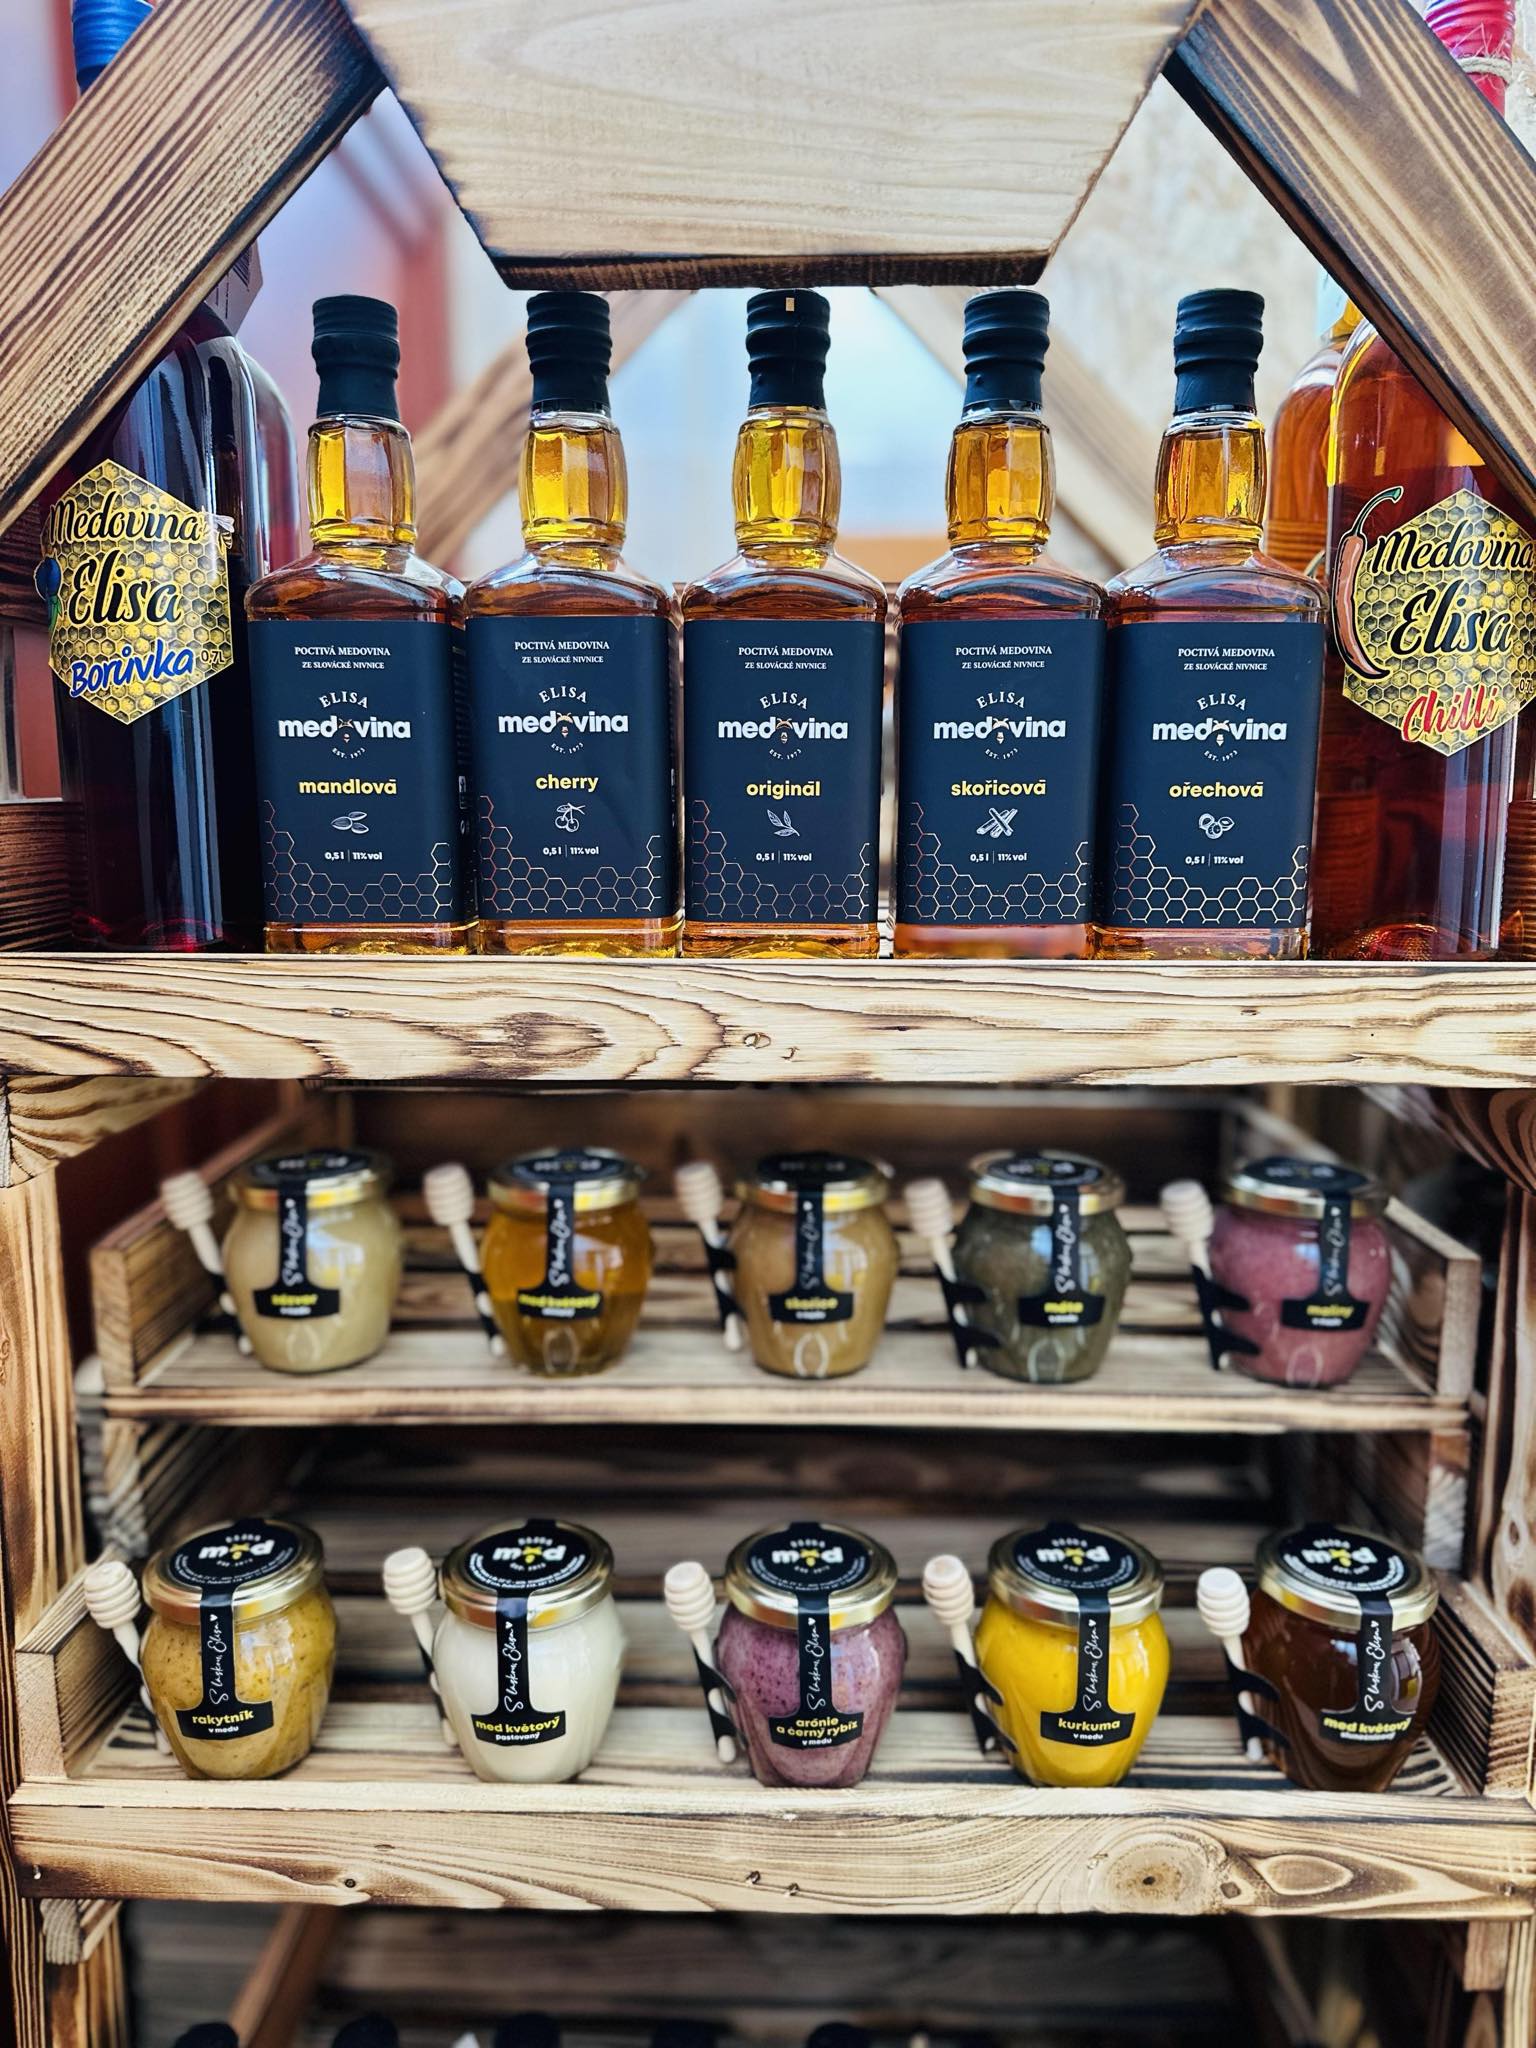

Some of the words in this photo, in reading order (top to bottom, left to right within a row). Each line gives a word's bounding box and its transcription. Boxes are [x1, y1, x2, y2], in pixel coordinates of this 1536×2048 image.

[49, 490, 201, 544] Medovina
[1370, 519, 1535, 575] Medovina
[68, 549, 182, 624] Elisa
[1390, 578, 1514, 655] Elisa
[295, 645, 336, 656] POCTIVÁ
[339, 646, 390, 656] MEDOVINA
[514, 639, 556, 650] POCTIVÁ
[558, 640, 610, 650] MEDOVINA
[738, 645, 780, 656] POCTIVÁ
[782, 646, 833, 656] MEDOVINA
[956, 645, 997, 656] POCTIVÁ
[1000, 646, 1052, 655] MEDOVINA
[1178, 646, 1220, 657] POCTIVÁ
[1222, 647, 1275, 657] MEDOVINA
[70, 638, 194, 698] Borůvka
[302, 661, 311, 669] ZE
[353, 661, 385, 669] NIVNICE
[573, 655, 604, 663] NIVNICE
[962, 661, 972, 669] ZE
[1013, 660, 1045, 668] NIVNICE
[1235, 662, 1268, 670] NIVNICE
[319, 690, 368, 709] ELISA
[538, 685, 588, 704] ELISA
[759, 691, 809, 710] ELISA
[976, 691, 1026, 709] ELISA
[1196, 692, 1247, 711] ELISA
[1402, 684, 1499, 742] Chilli
[535, 774, 599, 792] cherry
[475, 1720, 503, 1732] med
[1058, 1717, 1121, 1731] kurkuma
